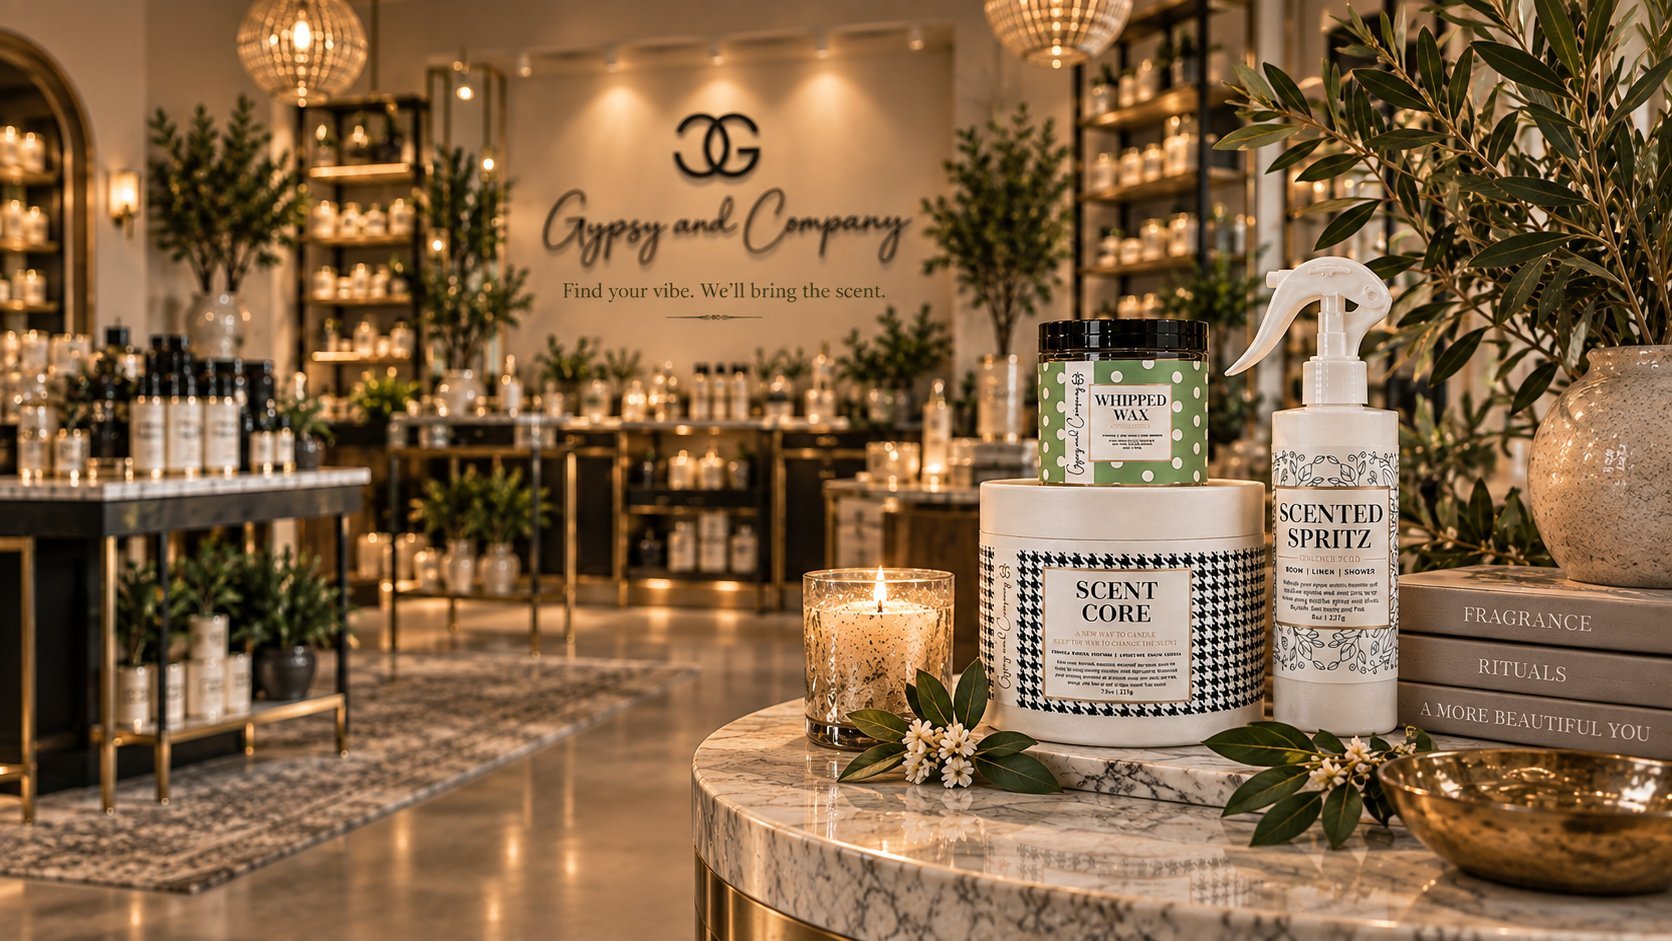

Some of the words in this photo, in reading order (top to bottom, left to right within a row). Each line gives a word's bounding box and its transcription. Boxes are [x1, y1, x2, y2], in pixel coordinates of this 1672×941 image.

[543, 189, 667, 268] Gypsy
[673, 196, 737, 236] and
[743, 188, 911, 264] Company
[563, 282, 602, 299] Find
[608, 287, 648, 302] your
[653, 282, 694, 299] vibe.
[750, 282, 797, 302] bring
[802, 282, 830, 299] the
[835, 283, 886, 299] scent.
[1095, 394, 1167, 407] WHIPPED
[1113, 408, 1149, 421] WAX
[1279, 502, 1384, 524] SCENTED
[1287, 527, 1372, 549] SPRITZ
[1076, 580, 1159, 600] SCENT
[1082, 603, 1152, 623] CORE
[1464, 606, 1592, 632] FRAGRANCE
[1478, 658, 1567, 683] RITUALS
[1420, 702, 1432, 716] A
[1437, 703, 1489, 723] MORE
[1495, 710, 1602, 737] BEAUTIFUL
[1608, 722, 1651, 742] YOU
